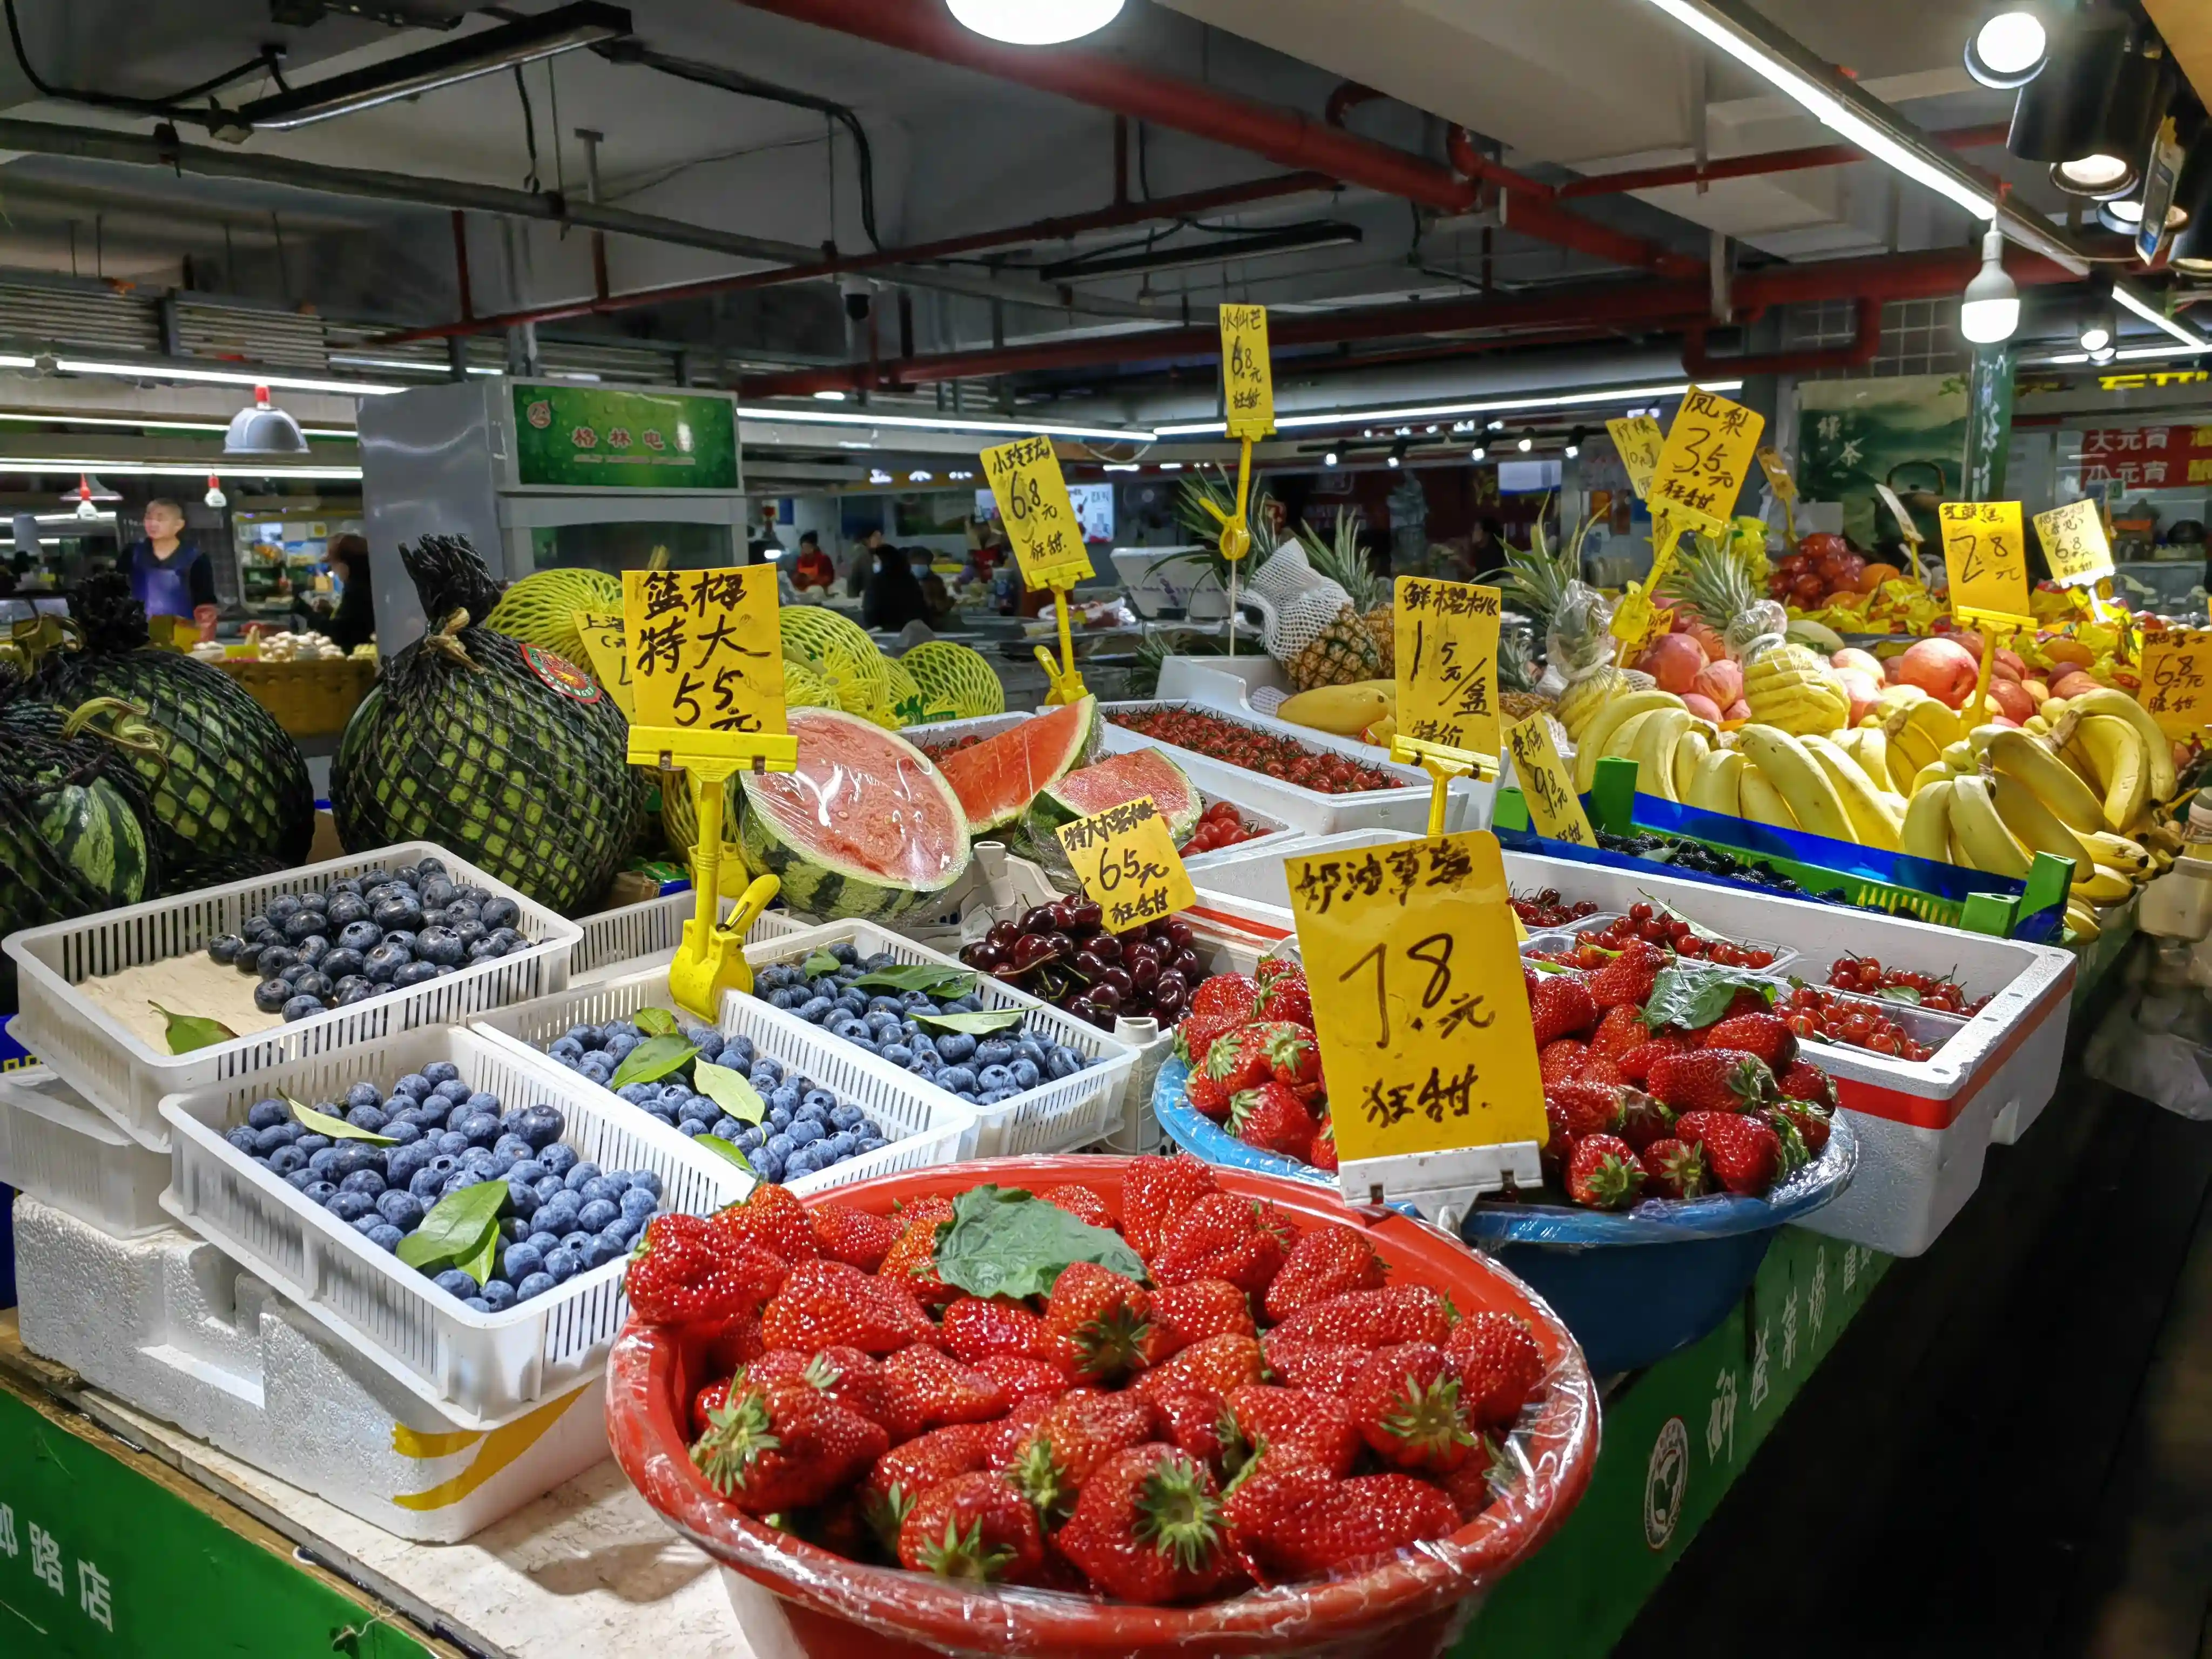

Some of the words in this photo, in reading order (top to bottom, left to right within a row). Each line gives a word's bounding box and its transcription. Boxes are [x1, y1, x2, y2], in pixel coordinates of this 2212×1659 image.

[1011, 471, 1057, 520] 6.8元
[637, 614, 772, 676] 特大
[1100, 847, 1170, 891] 65元
[1339, 934, 1495, 1048] 7.8元
